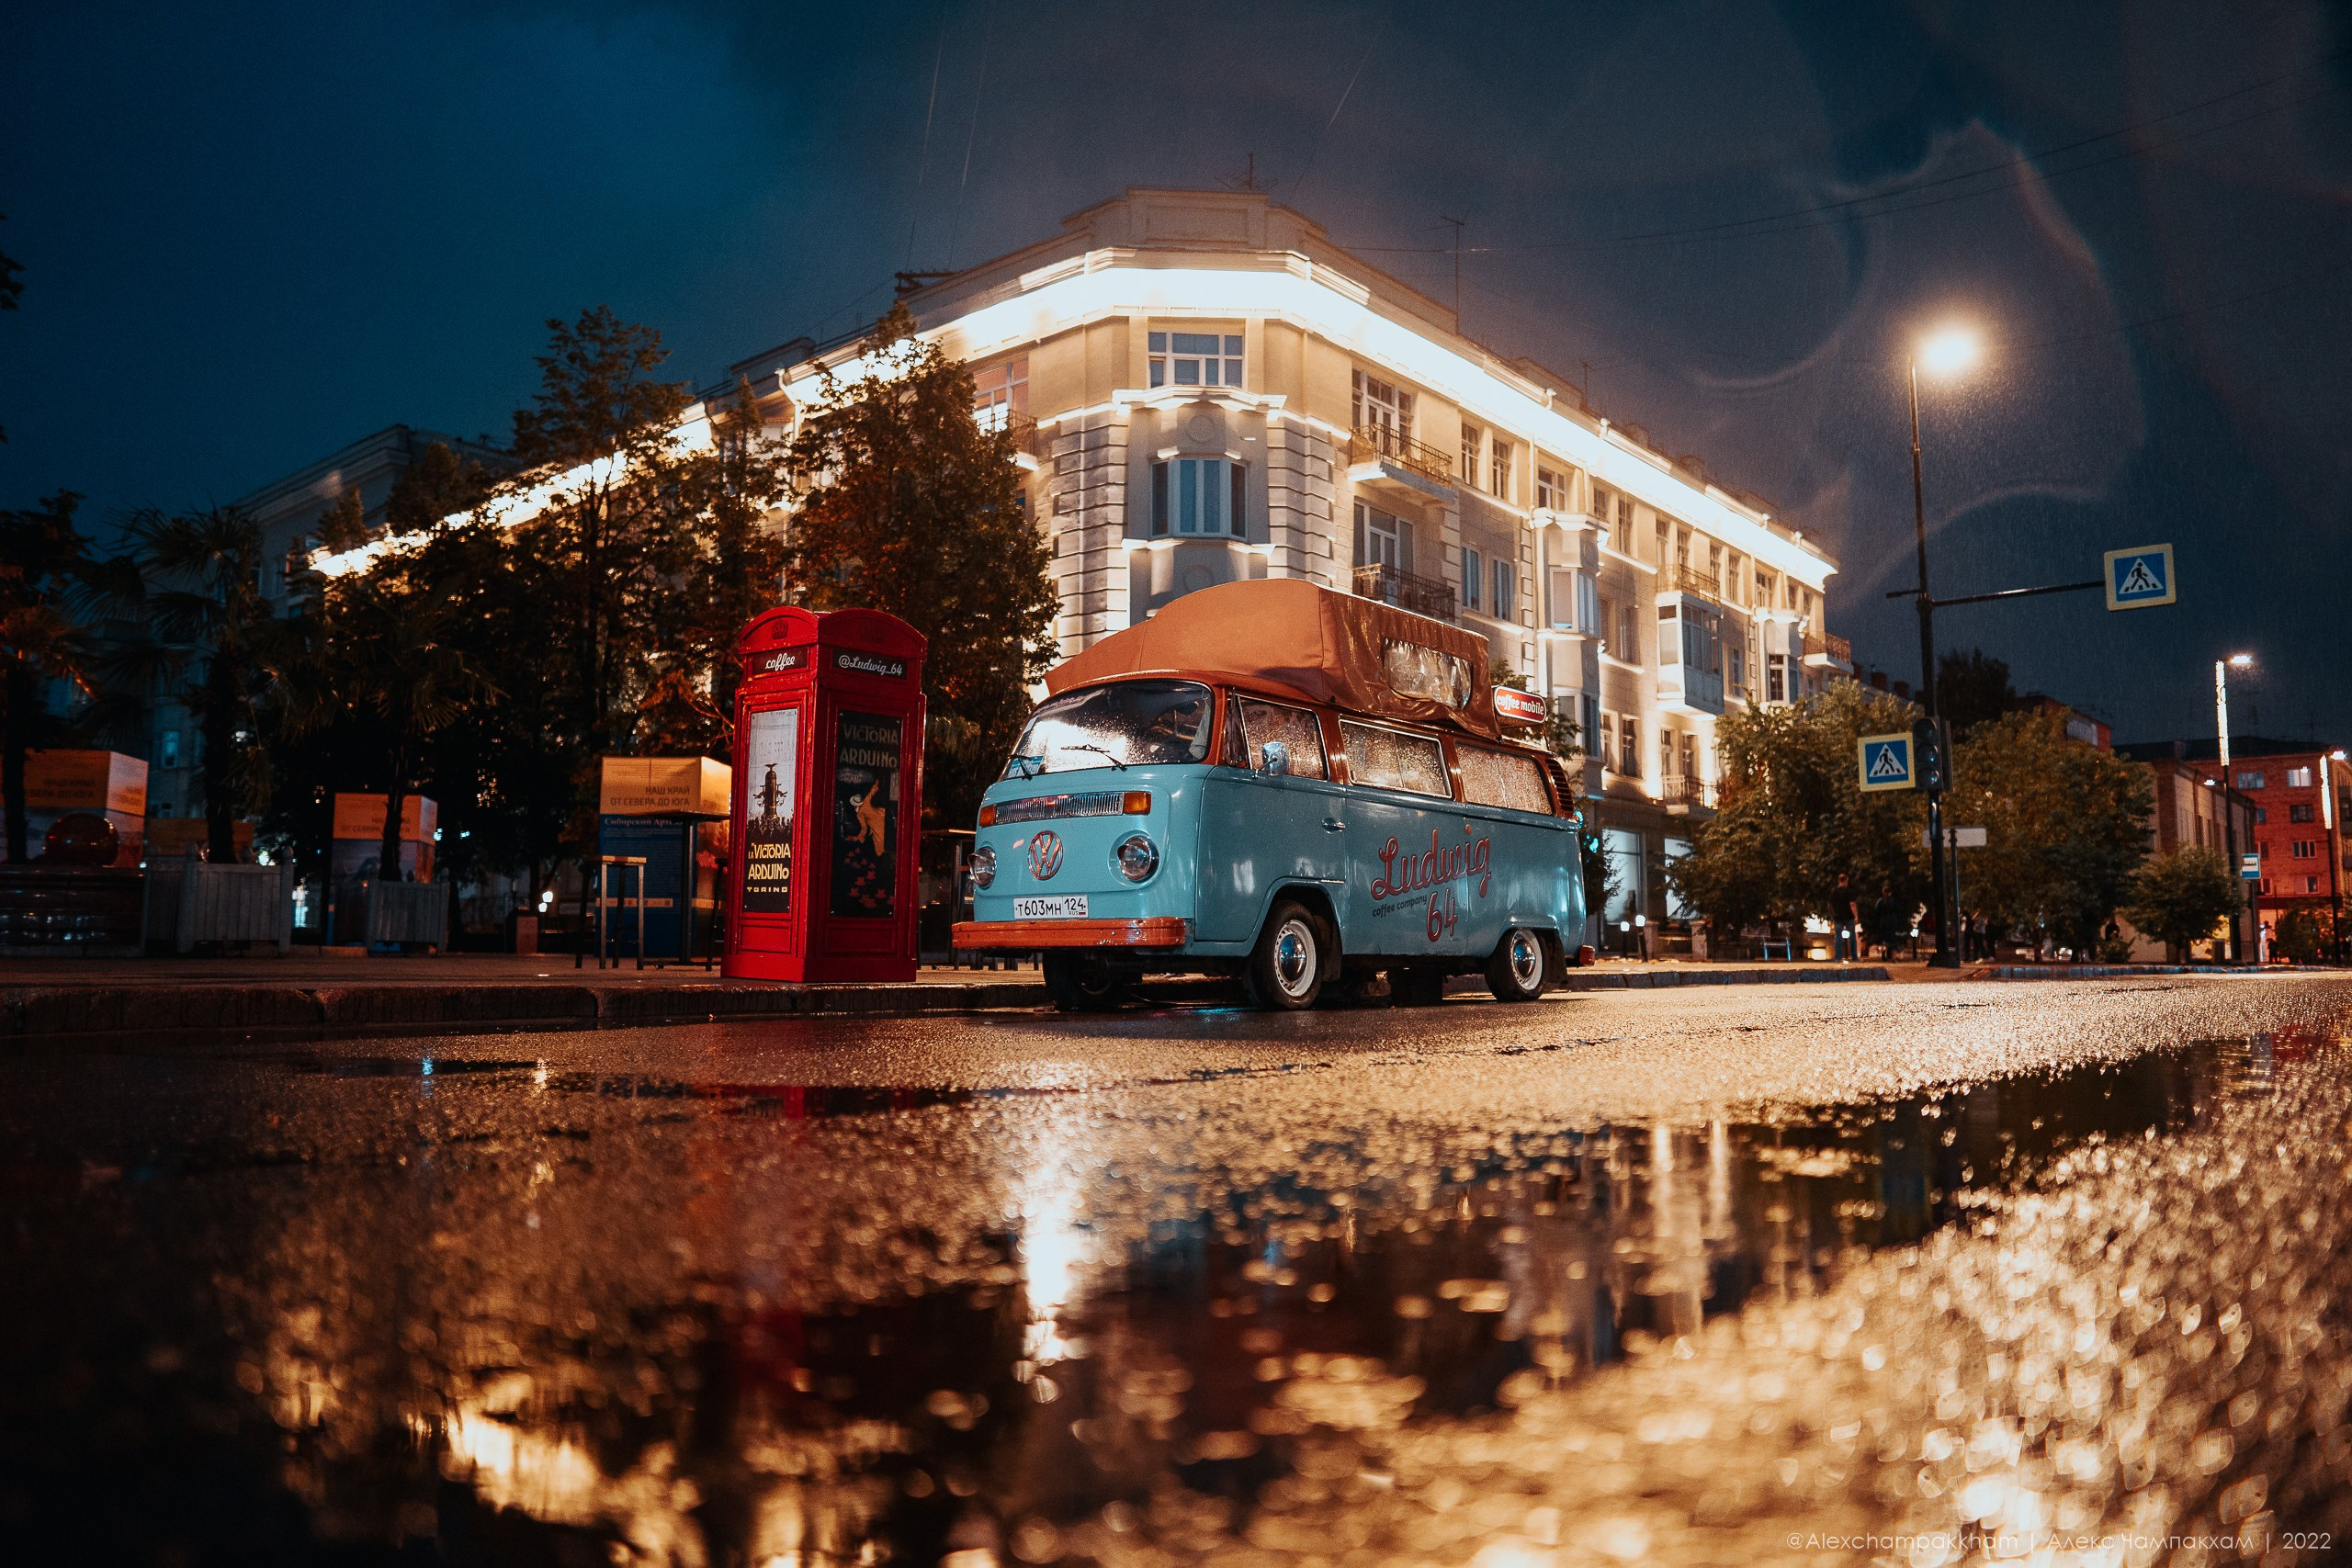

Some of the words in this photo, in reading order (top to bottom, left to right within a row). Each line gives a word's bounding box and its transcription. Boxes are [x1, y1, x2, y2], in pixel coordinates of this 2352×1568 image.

[764, 652, 796, 671] coffee
[838, 654, 903, 676] @Ludwig_64
[1497, 694, 1520, 711] coffee
[1521, 700, 1544, 716] mobile
[842, 722, 899, 746] VICTORIA
[839, 747, 898, 769] ARDUINO
[610, 797, 623, 807] ОТ
[624, 797, 656, 807] СЕВЕРА
[658, 797, 670, 807] ДО
[754, 843, 791, 859] VICTORIA
[1370, 823, 1491, 900] Ludwig
[748, 863, 790, 880] ARDUINO
[1373, 903, 1396, 918] coffee
[1396, 895, 1428, 909] company
[1427, 887, 1459, 942] 64
